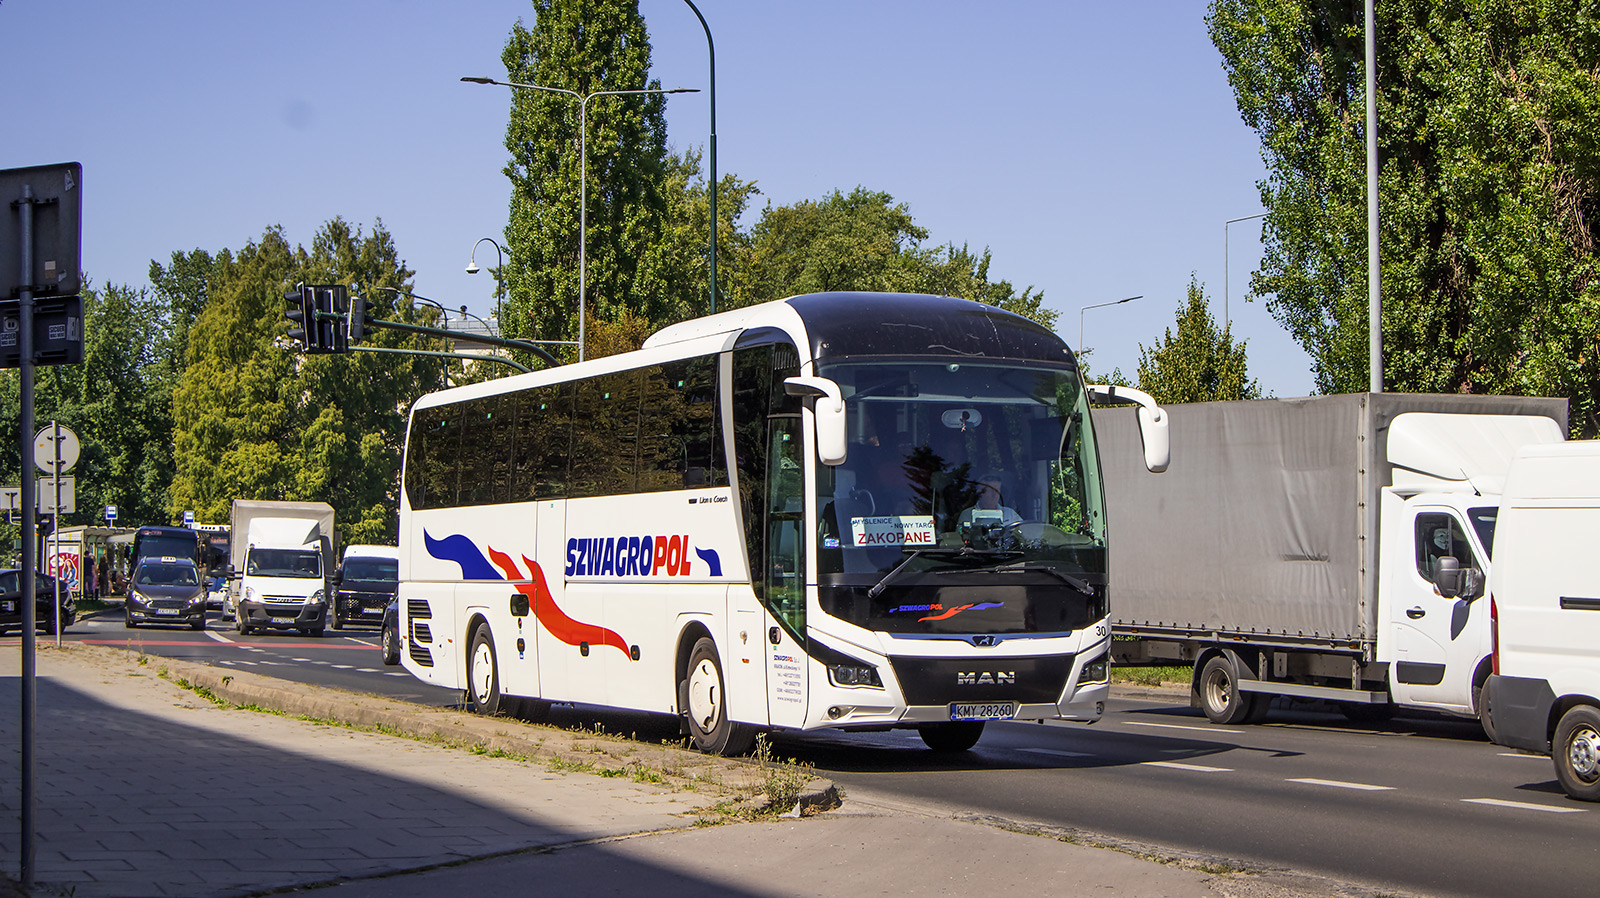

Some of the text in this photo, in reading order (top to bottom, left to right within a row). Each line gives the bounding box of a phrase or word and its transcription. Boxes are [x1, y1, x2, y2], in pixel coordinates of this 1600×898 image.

[713, 495, 728, 503] Coach
[915, 521, 932, 529] TARG
[858, 531, 932, 545] ZAKOPANE
[564, 534, 692, 577] SZWAGROPOL
[899, 603, 943, 611] SZWAGROPOL
[1096, 625, 1106, 637] 30
[957, 671, 1015, 685] MAN
[957, 704, 1012, 716] KMY 28260
